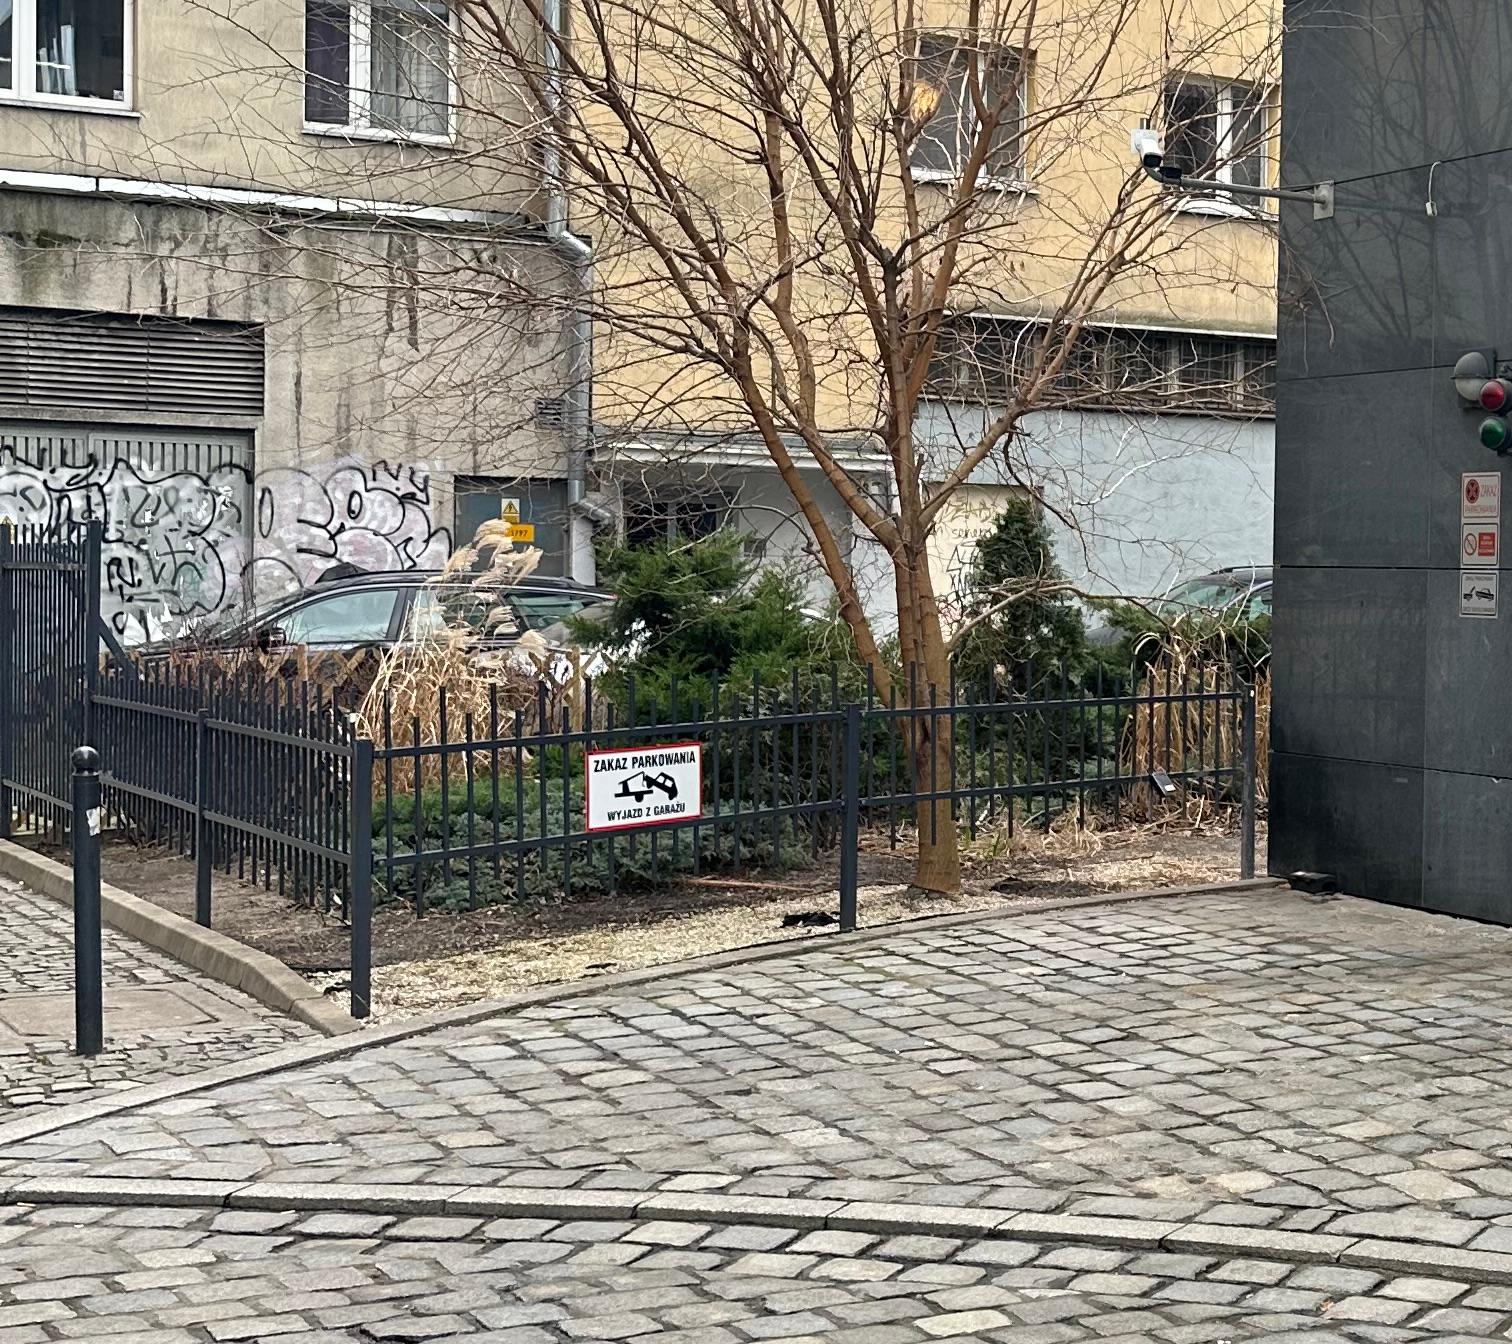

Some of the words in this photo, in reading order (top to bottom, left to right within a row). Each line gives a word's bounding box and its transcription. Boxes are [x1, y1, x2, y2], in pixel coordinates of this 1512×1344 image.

[594, 757, 628, 773] ZAKAZ
[631, 750, 696, 769] PARKOWANIA
[607, 807, 643, 821] WYJAZD
[646, 806, 651, 817] Z
[653, 801, 686, 816] GARAŻU
